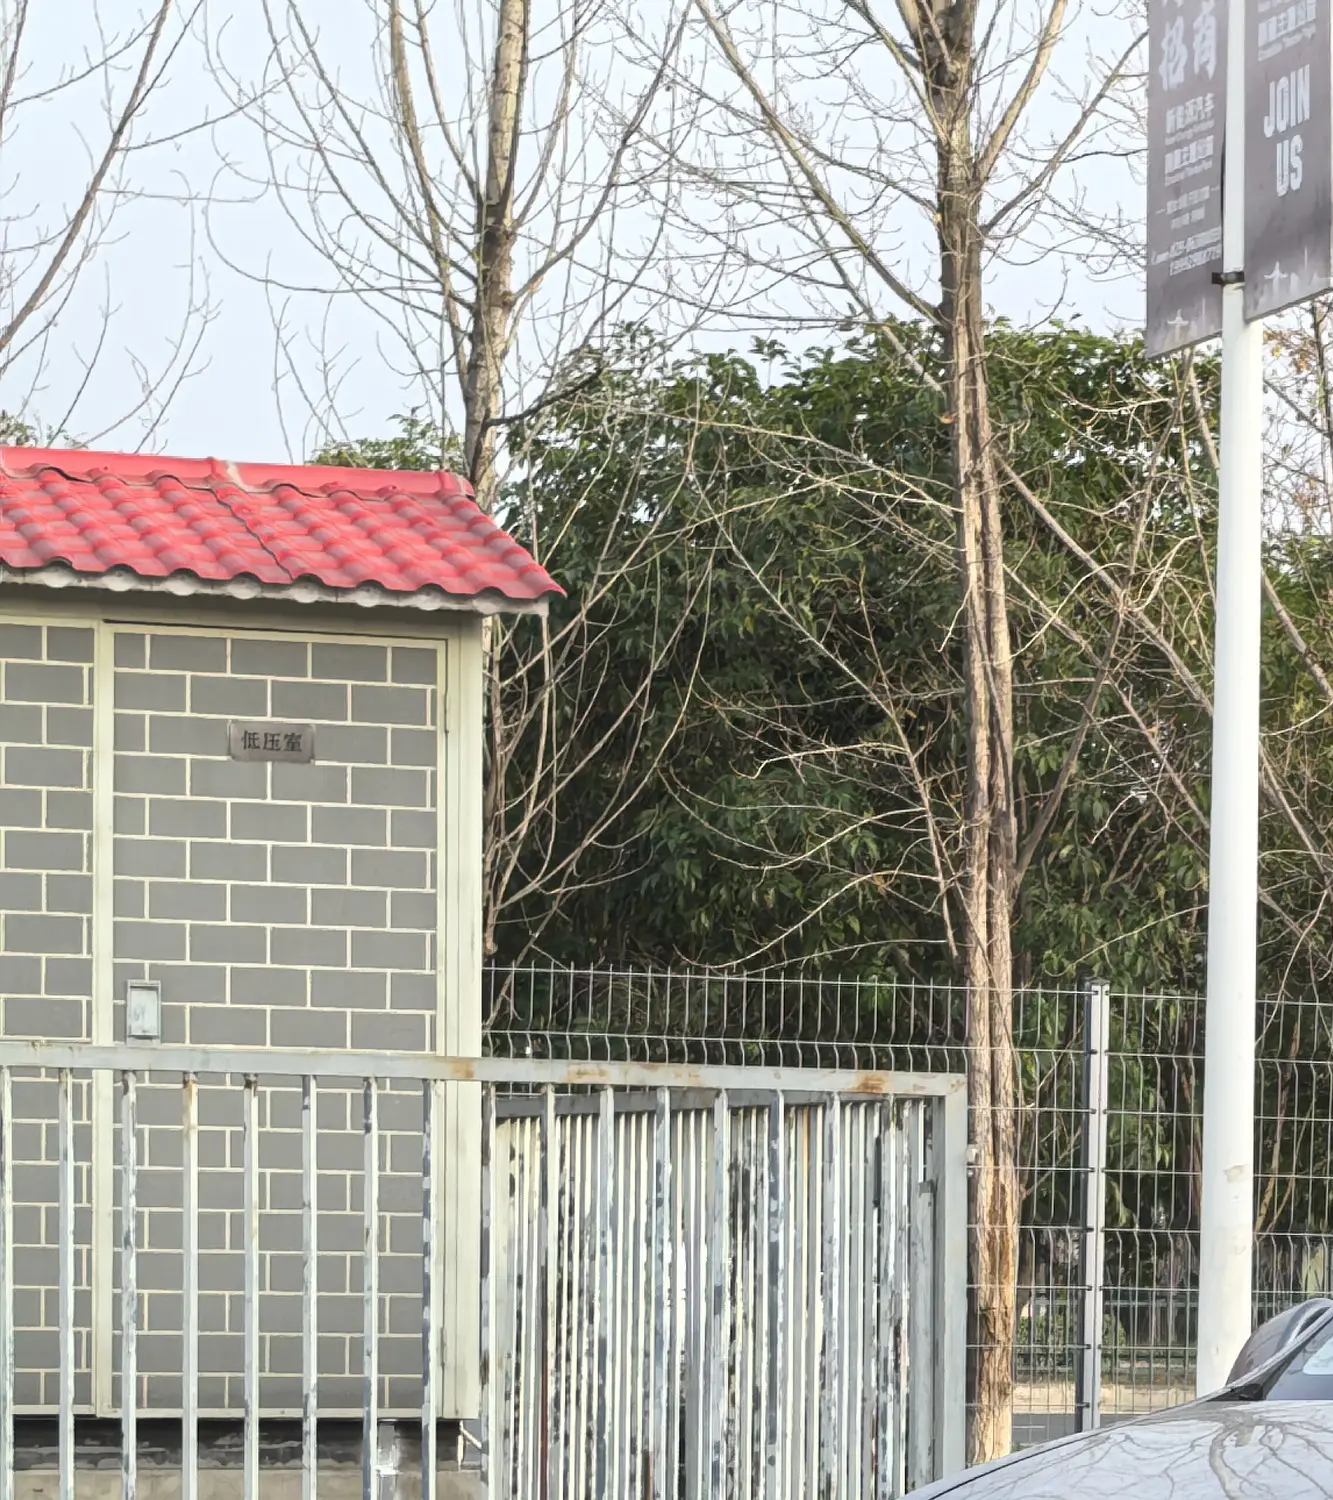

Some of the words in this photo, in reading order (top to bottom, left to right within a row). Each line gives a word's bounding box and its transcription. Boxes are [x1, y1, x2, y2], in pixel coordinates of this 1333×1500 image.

[1263, 64, 1311, 138] JOIN
[1276, 135, 1304, 197] US
[241, 730, 302, 752] 低压室
